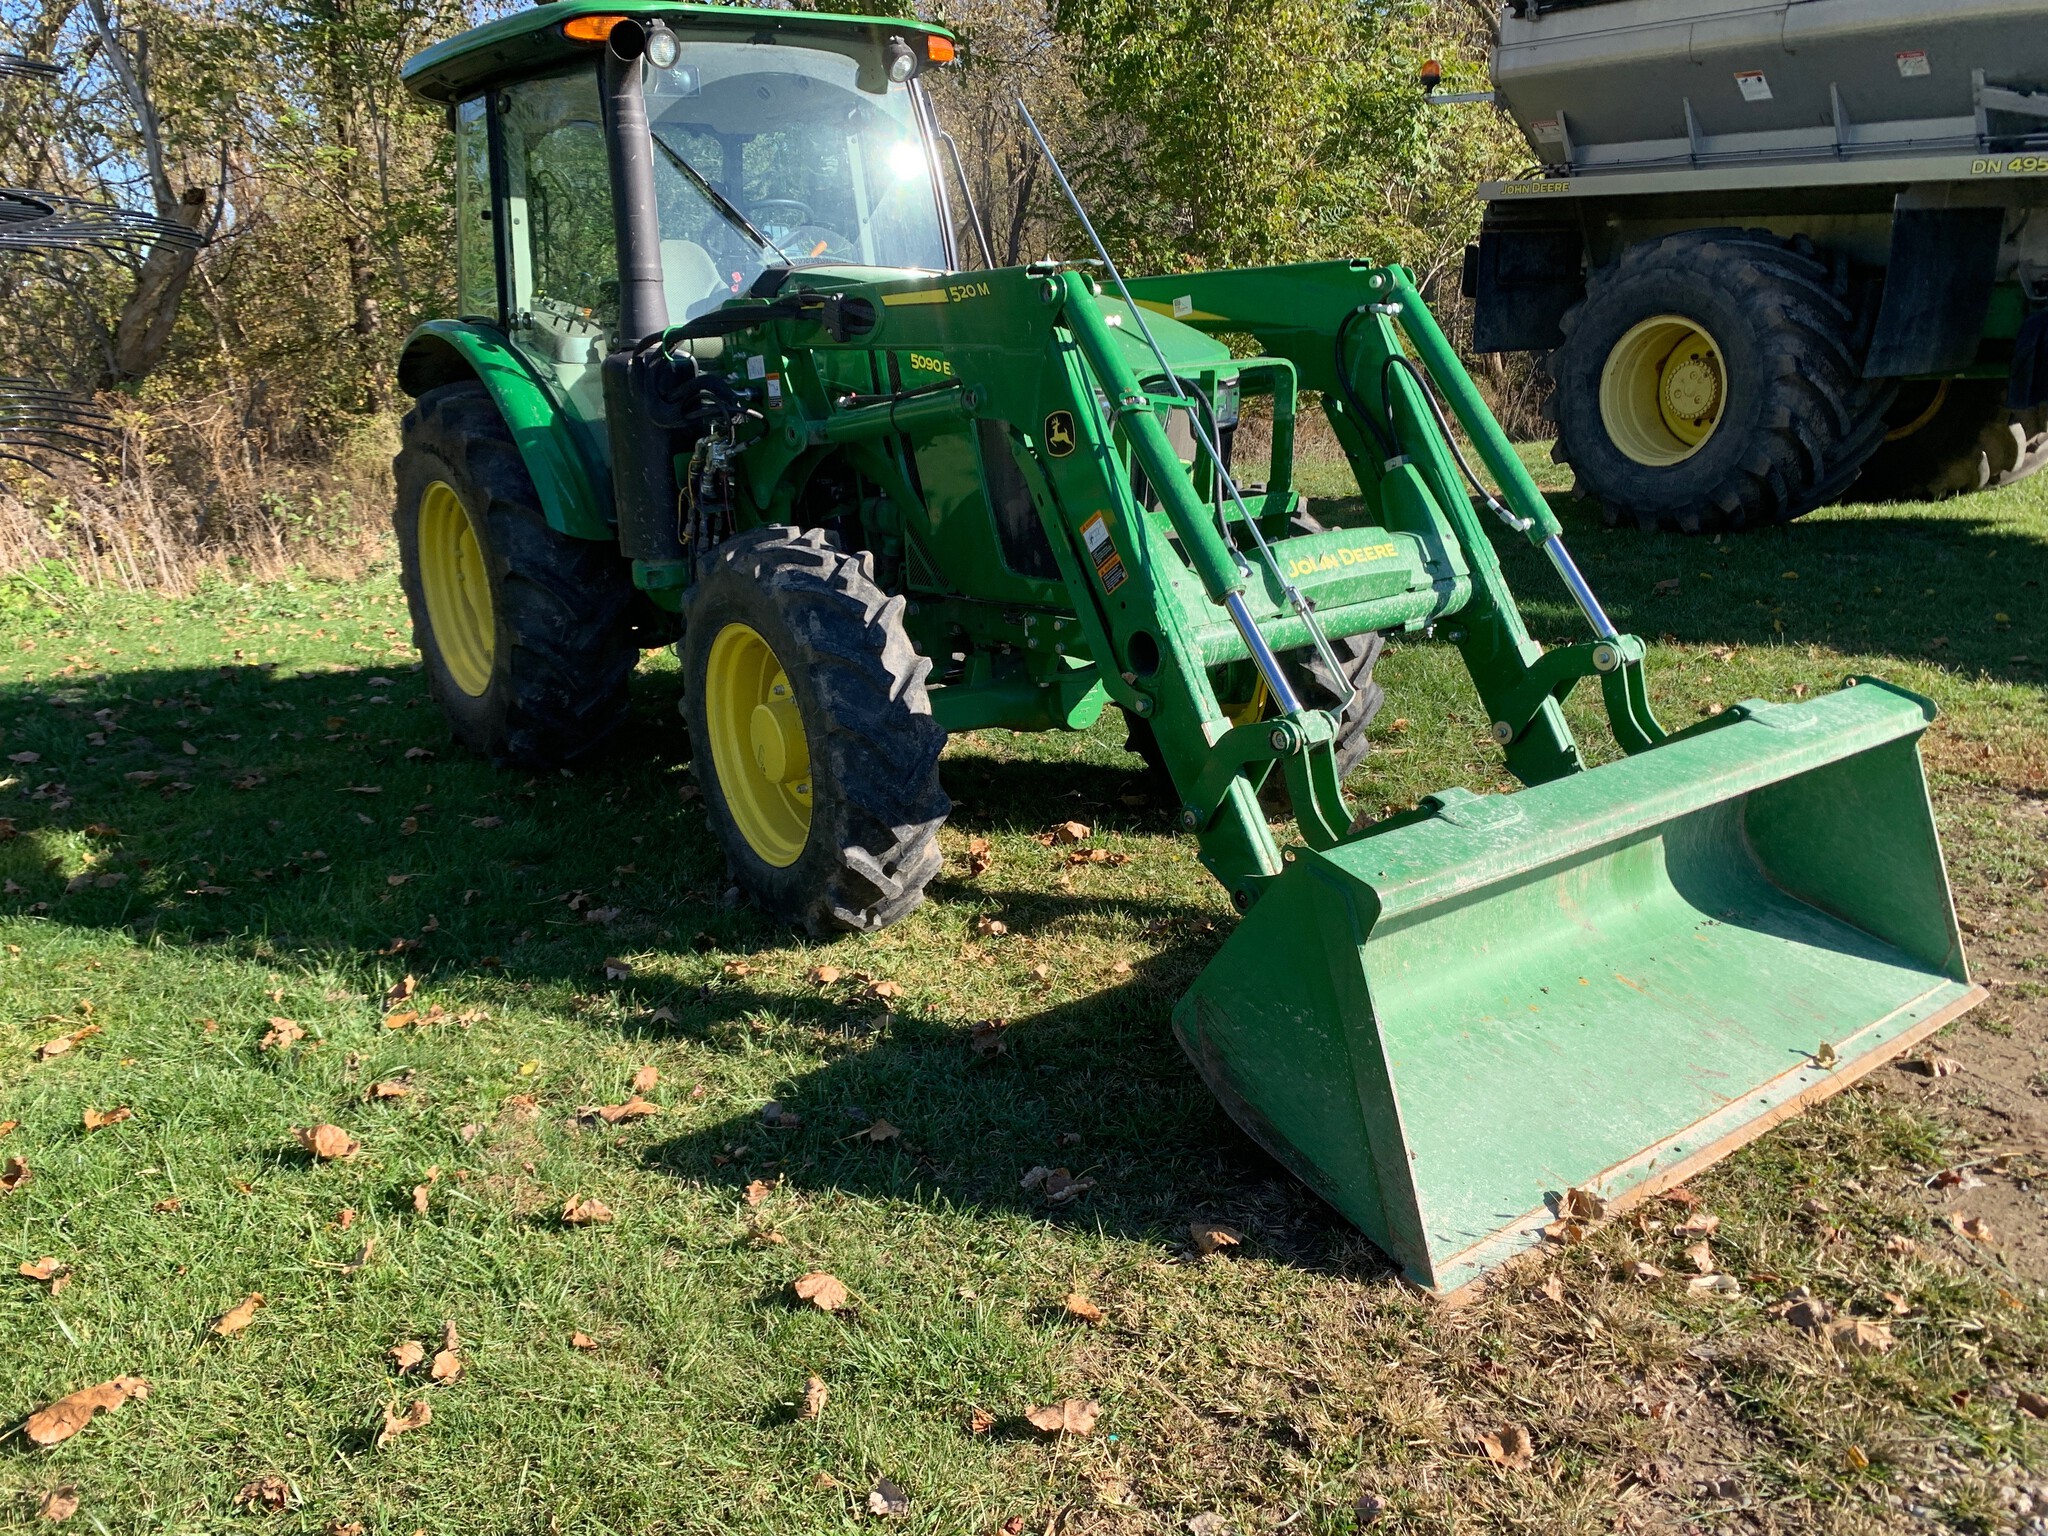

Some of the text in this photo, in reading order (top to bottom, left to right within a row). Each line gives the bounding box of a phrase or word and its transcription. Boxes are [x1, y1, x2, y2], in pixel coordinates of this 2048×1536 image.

[1971, 159, 2002, 174] DN
[1501, 182, 1570, 195] JOHN DEERE
[949, 282, 990, 302] 520 M
[910, 353, 952, 376] 5090 E
[1337, 543, 1398, 566] DEERE
